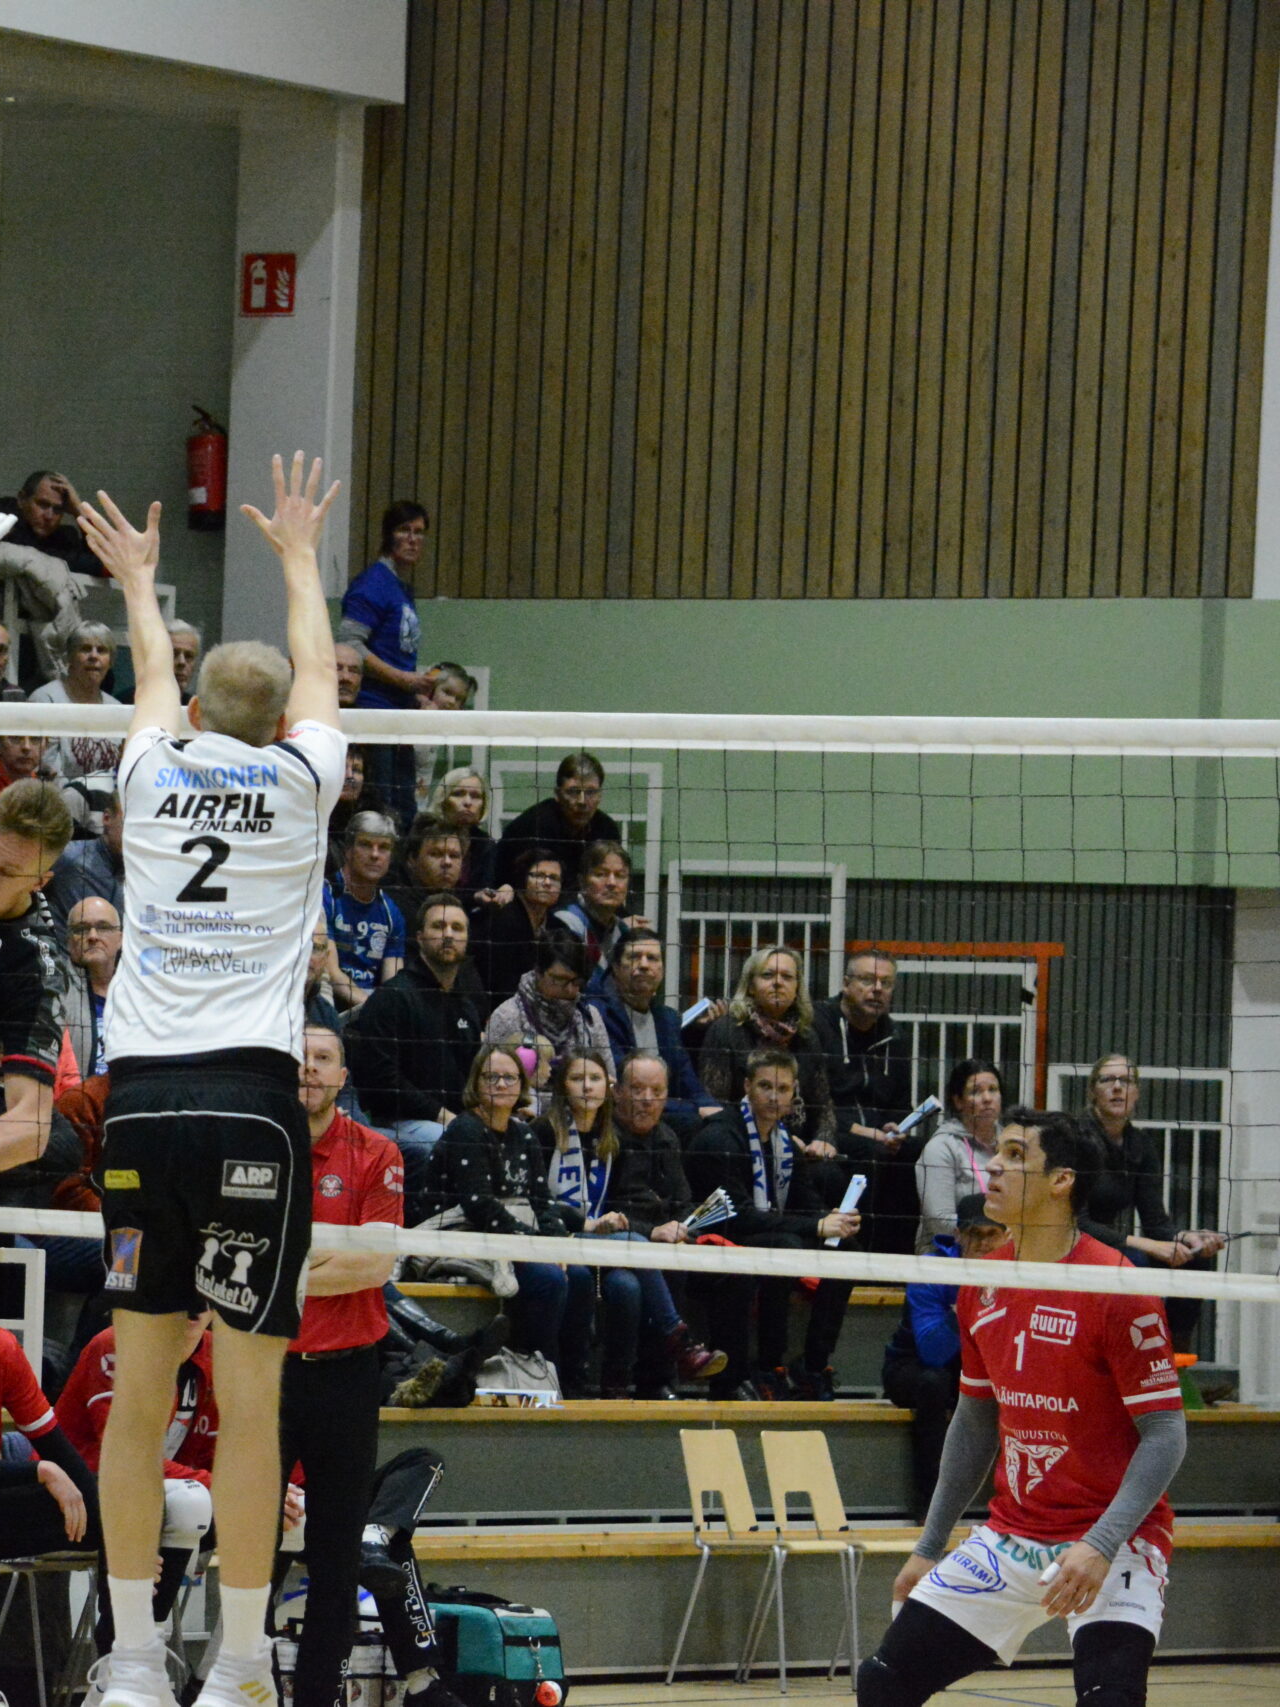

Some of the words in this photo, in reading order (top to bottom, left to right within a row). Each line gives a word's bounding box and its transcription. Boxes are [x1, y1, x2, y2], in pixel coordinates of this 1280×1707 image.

[154, 765, 279, 788] SINKKONEN
[155, 793, 276, 819] AIRFIL
[189, 820, 272, 833] FINLAND
[176, 835, 231, 902] 2
[163, 910, 235, 921] TOIJALAN
[164, 922, 251, 934] TILITOIMISTO
[254, 925, 276, 936] OY
[356, 921, 369, 940] 9
[230, 1165, 273, 1186] ARP
[239, 1286, 260, 1315] Oy
[1030, 1313, 1077, 1337] RUUTU
[1013, 1330, 1026, 1371] 1
[1149, 1358, 1172, 1373] LML
[950, 1552, 994, 1585] KIRAMI
[1120, 1570, 1132, 1590] 1
[409, 1614, 432, 1649] Golf
